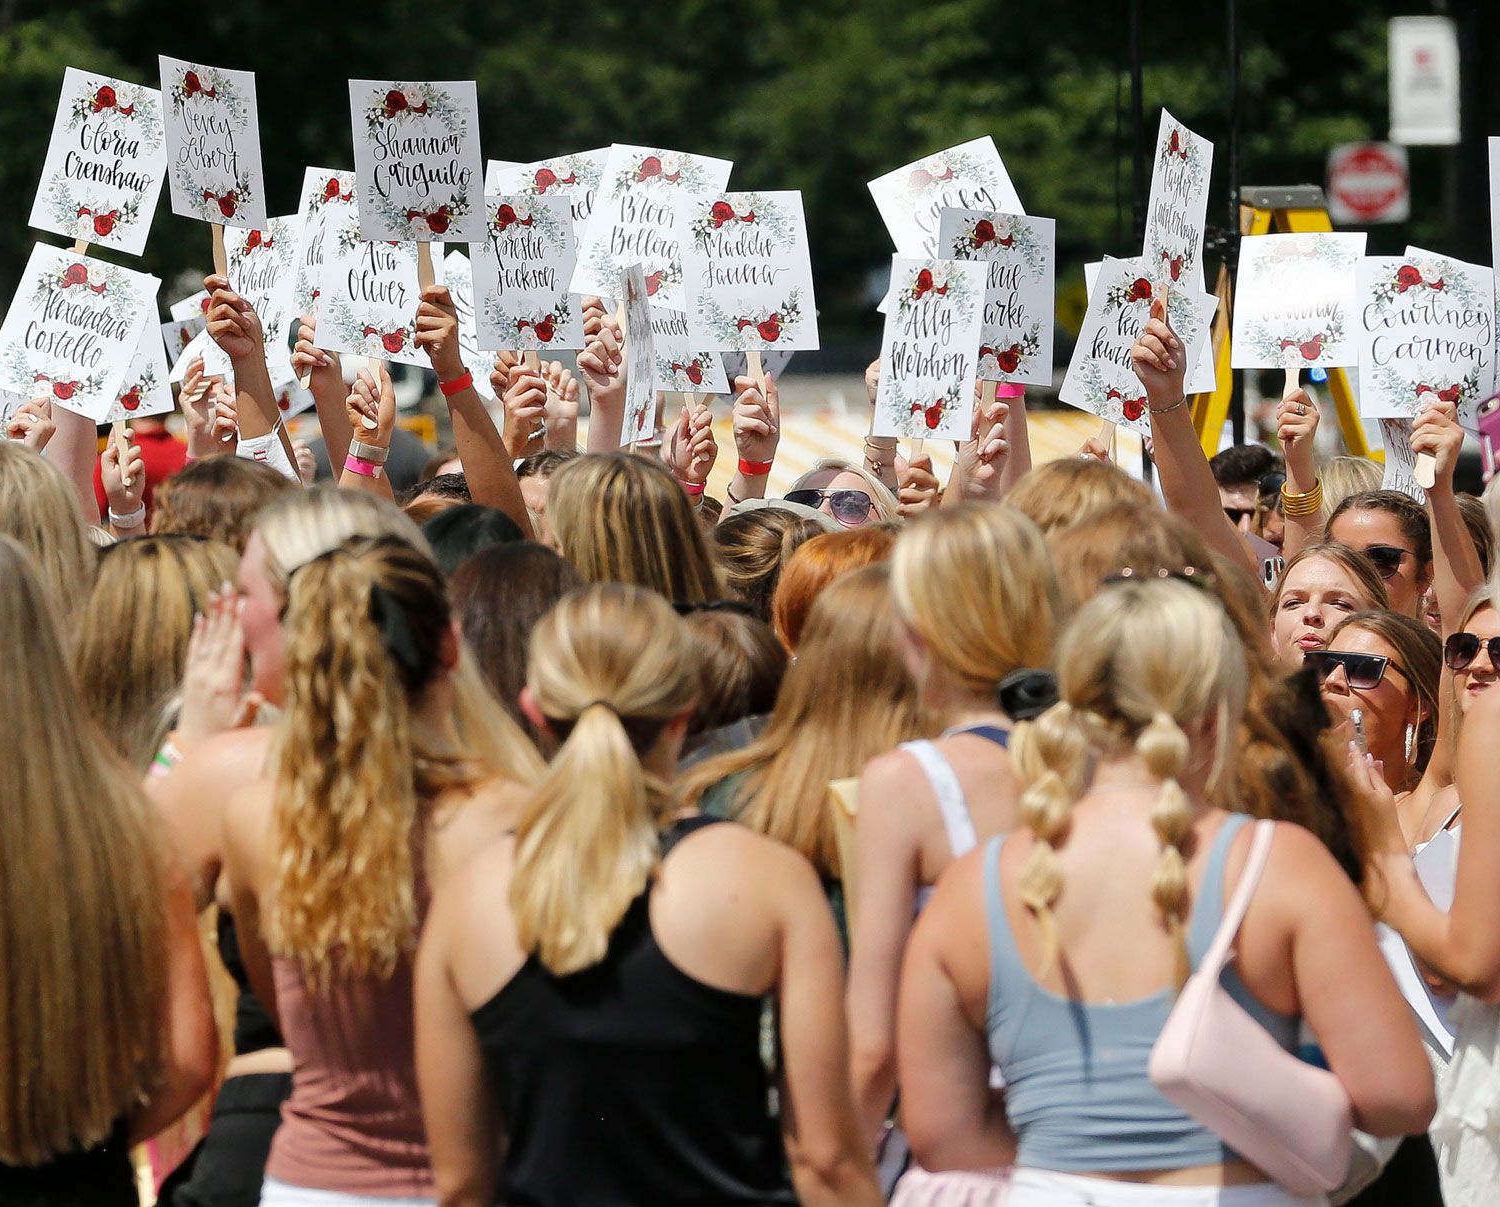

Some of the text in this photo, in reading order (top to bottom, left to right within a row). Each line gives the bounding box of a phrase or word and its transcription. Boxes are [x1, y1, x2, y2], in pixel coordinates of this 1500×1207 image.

[80, 121, 140, 159] Gloria
[179, 135, 240, 180] Libert
[373, 123, 461, 161] Shannon
[64, 150, 154, 193] Crenshaw
[361, 241, 401, 276] Ava
[348, 268, 412, 309] Oliver
[34, 288, 132, 342] Alexandria
[904, 300, 958, 347] Ally
[983, 291, 1029, 330] arke
[1362, 295, 1492, 346] Courtney
[24, 320, 104, 369] Costello
[1372, 335, 1488, 368] Carmen
